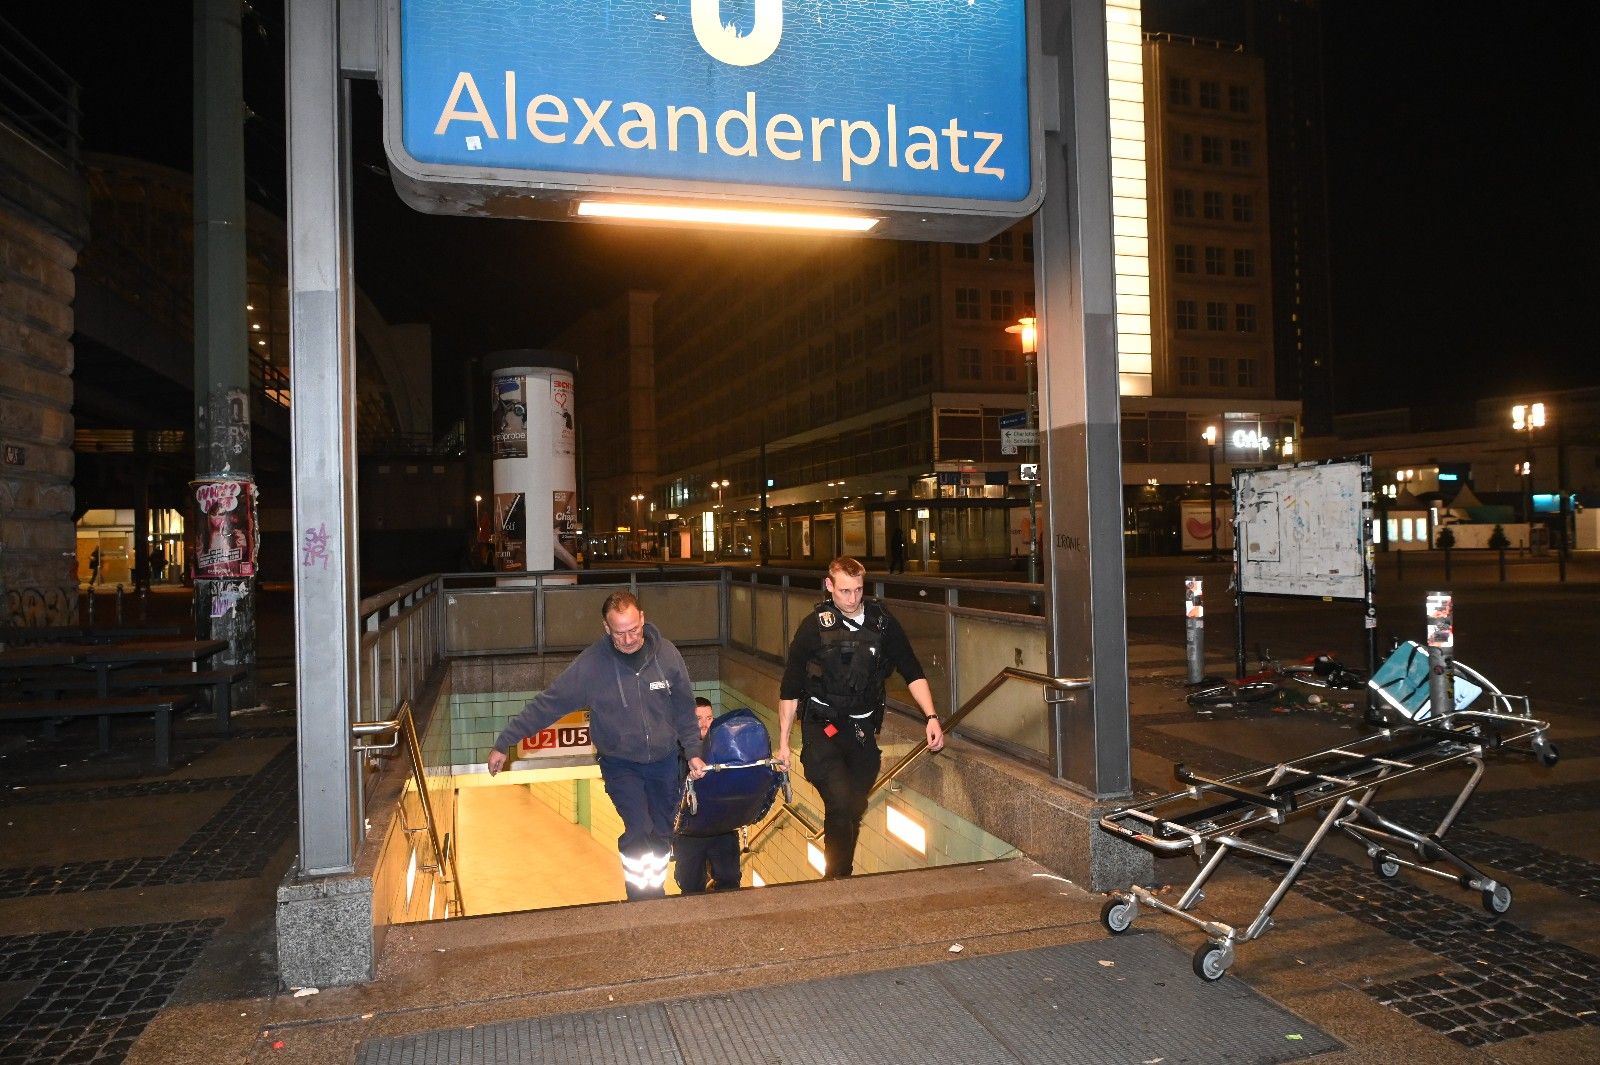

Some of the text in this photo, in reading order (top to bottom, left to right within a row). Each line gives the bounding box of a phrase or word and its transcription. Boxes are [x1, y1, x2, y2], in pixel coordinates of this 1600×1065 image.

[433, 70, 1006, 182] Alexanderplatz
[527, 728, 588, 748] U2 U5
